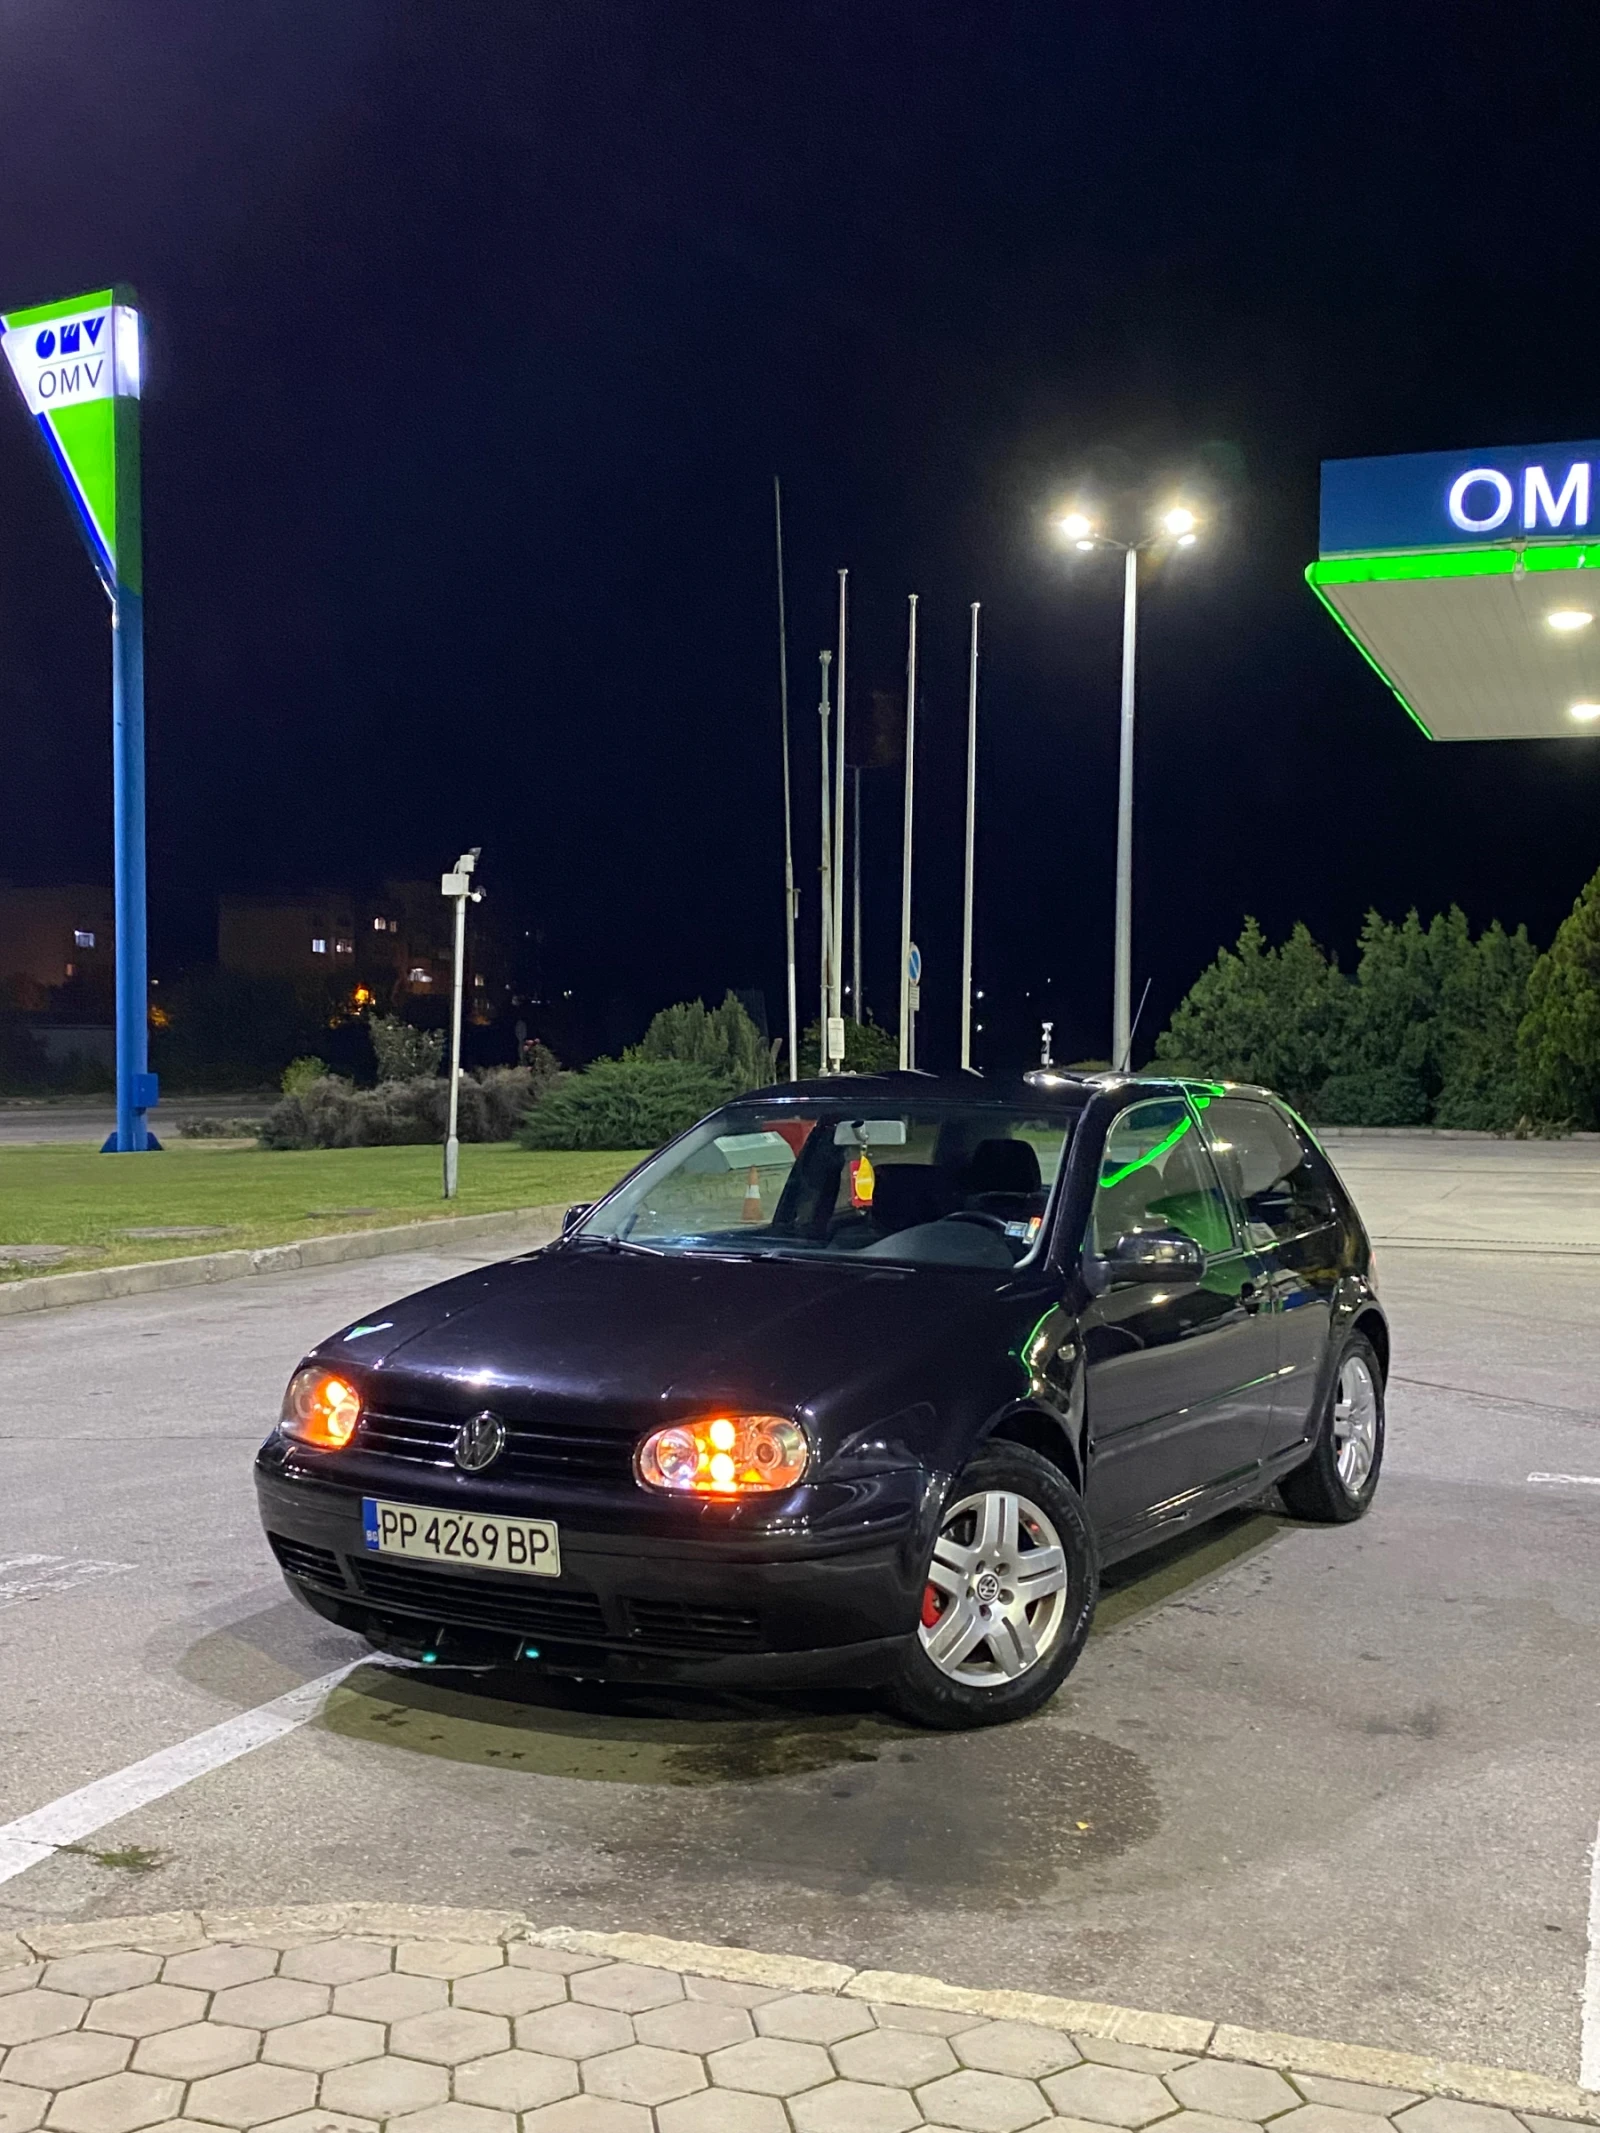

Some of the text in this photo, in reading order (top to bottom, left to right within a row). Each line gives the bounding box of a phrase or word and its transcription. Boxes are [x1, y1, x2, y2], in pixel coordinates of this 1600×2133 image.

[38, 360, 103, 398] OMV
[1450, 463, 1589, 532] OM
[366, 1530, 378, 1542] BG
[381, 1509, 549, 1565] PP 4269 BP
